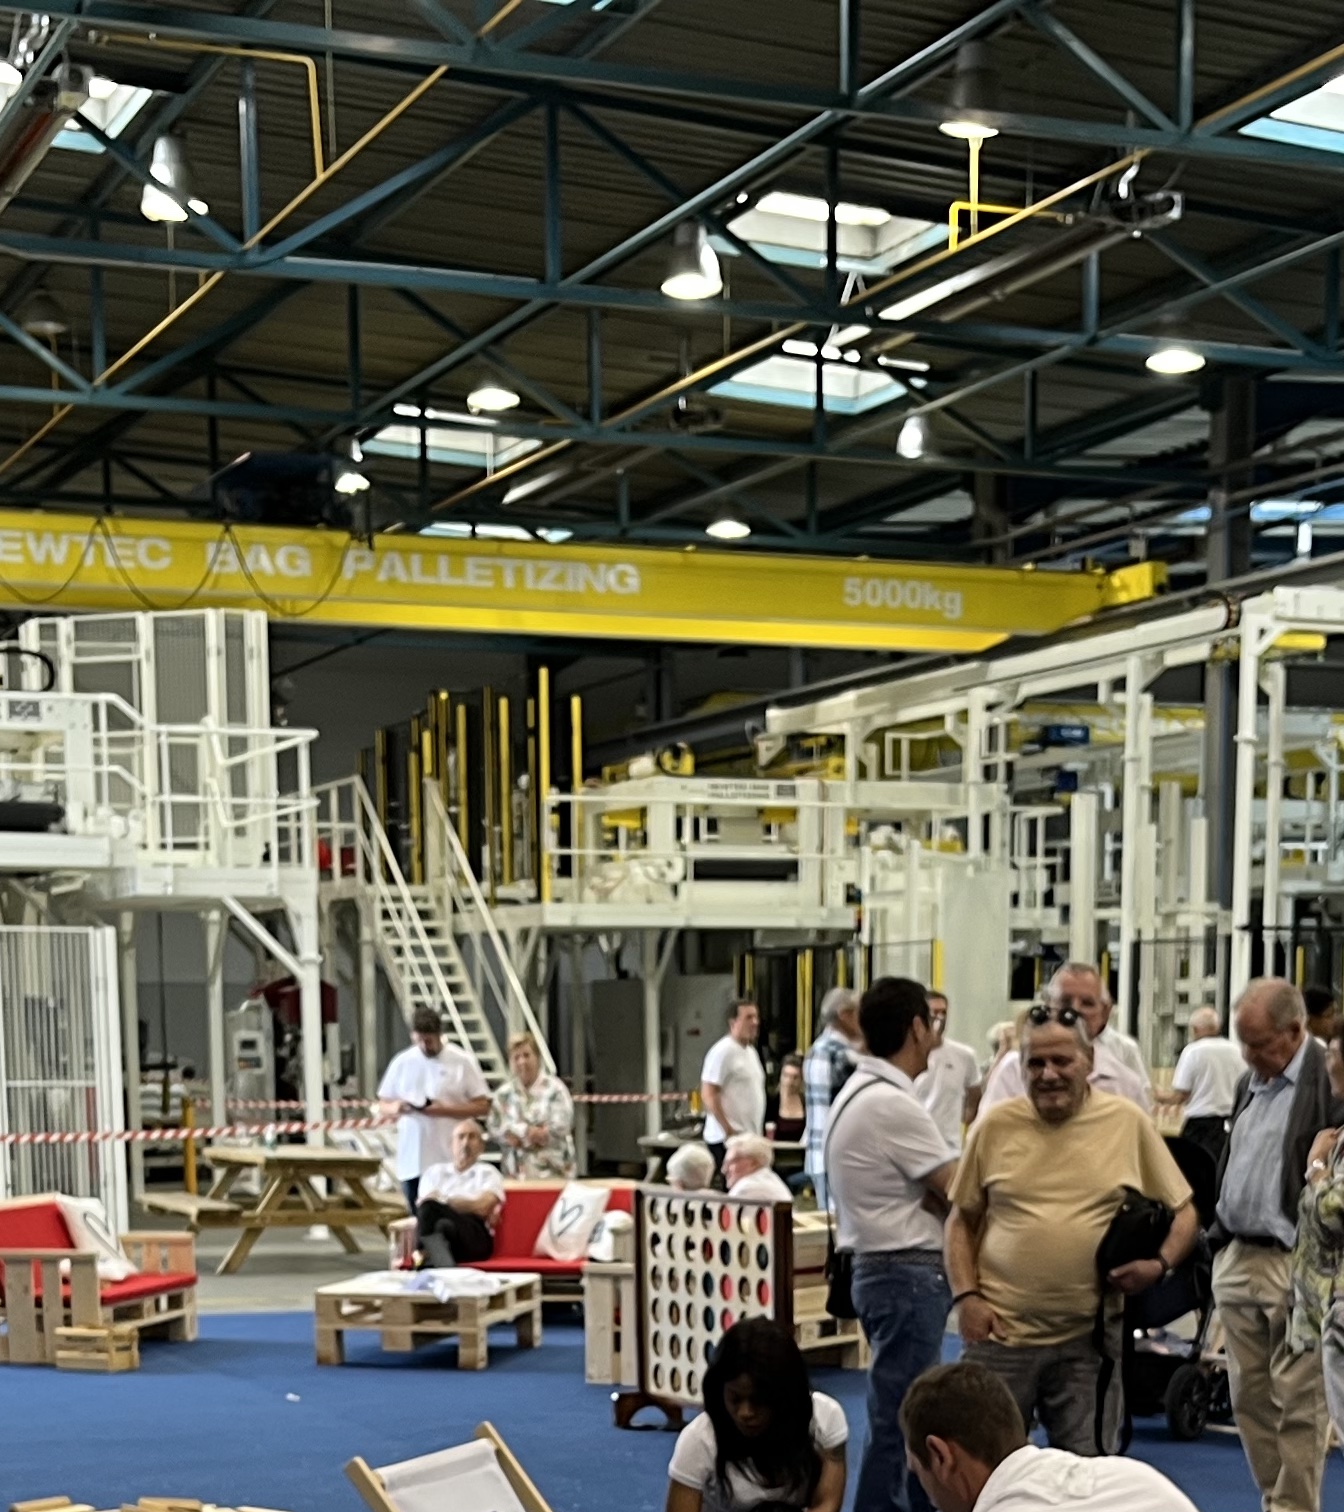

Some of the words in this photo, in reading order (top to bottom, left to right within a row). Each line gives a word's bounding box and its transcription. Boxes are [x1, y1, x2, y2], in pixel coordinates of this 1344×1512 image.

[205, 540, 312, 577] BAG
[341, 542, 642, 595] PALLETIZING
[843, 575, 964, 621] 5000kg
